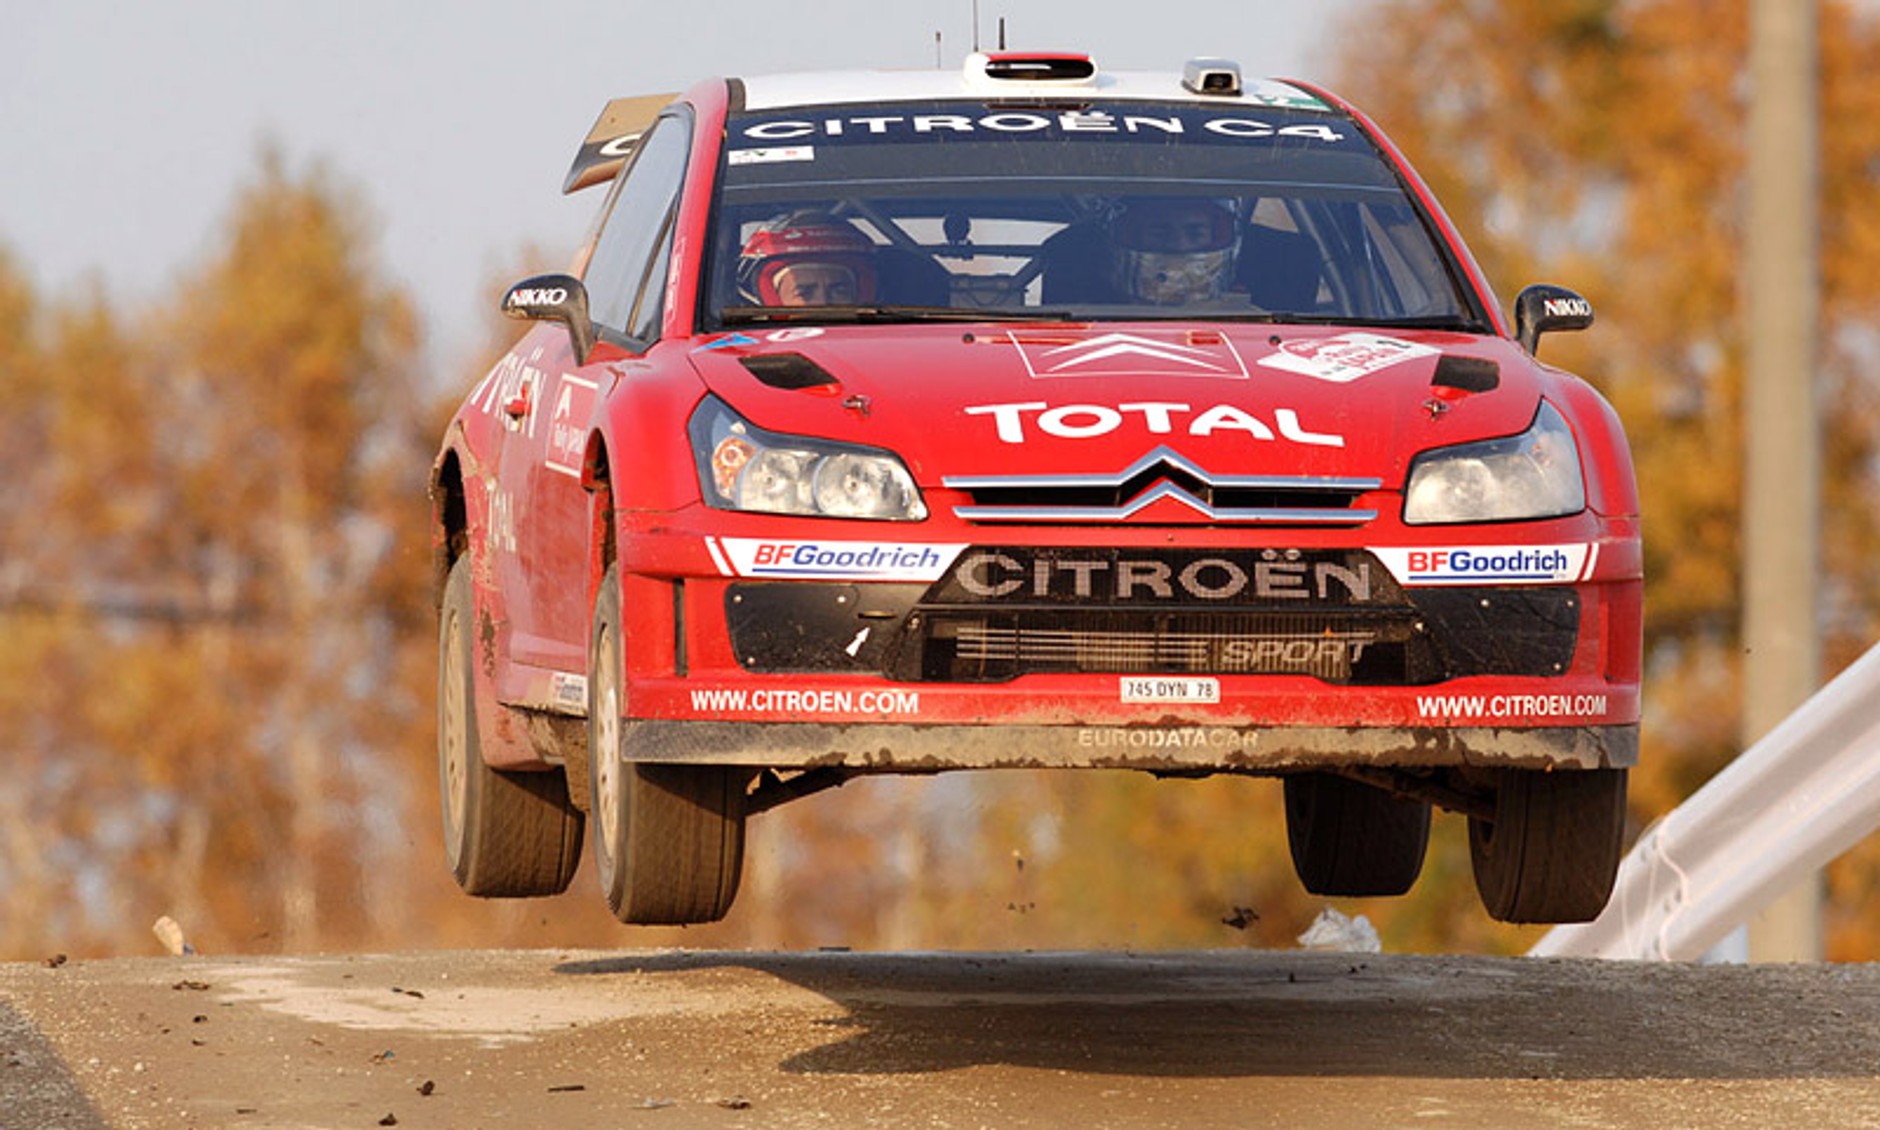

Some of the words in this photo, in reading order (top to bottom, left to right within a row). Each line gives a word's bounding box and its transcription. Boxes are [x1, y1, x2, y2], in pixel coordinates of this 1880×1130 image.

[744, 110, 1185, 138] CITROËN
[1204, 119, 1345, 142] C4
[508, 287, 568, 307] NIKKO
[1544, 298, 1592, 316] NIKKO
[964, 402, 1345, 447] TOTAL
[753, 543, 941, 568] BFGoodrich
[1408, 549, 1568, 572] BFGoodrich
[955, 549, 1371, 599] CITROËN
[1222, 640, 1375, 664] SPORT
[1127, 682, 1152, 697] 745
[1156, 682, 1188, 697] DYN
[1197, 682, 1213, 697] 78
[690, 690, 919, 714] WWW.CITROEN.COM
[1416, 695, 1607, 717] WWW.CITROEN.COM
[1078, 728, 1259, 747] EURODATACAR
